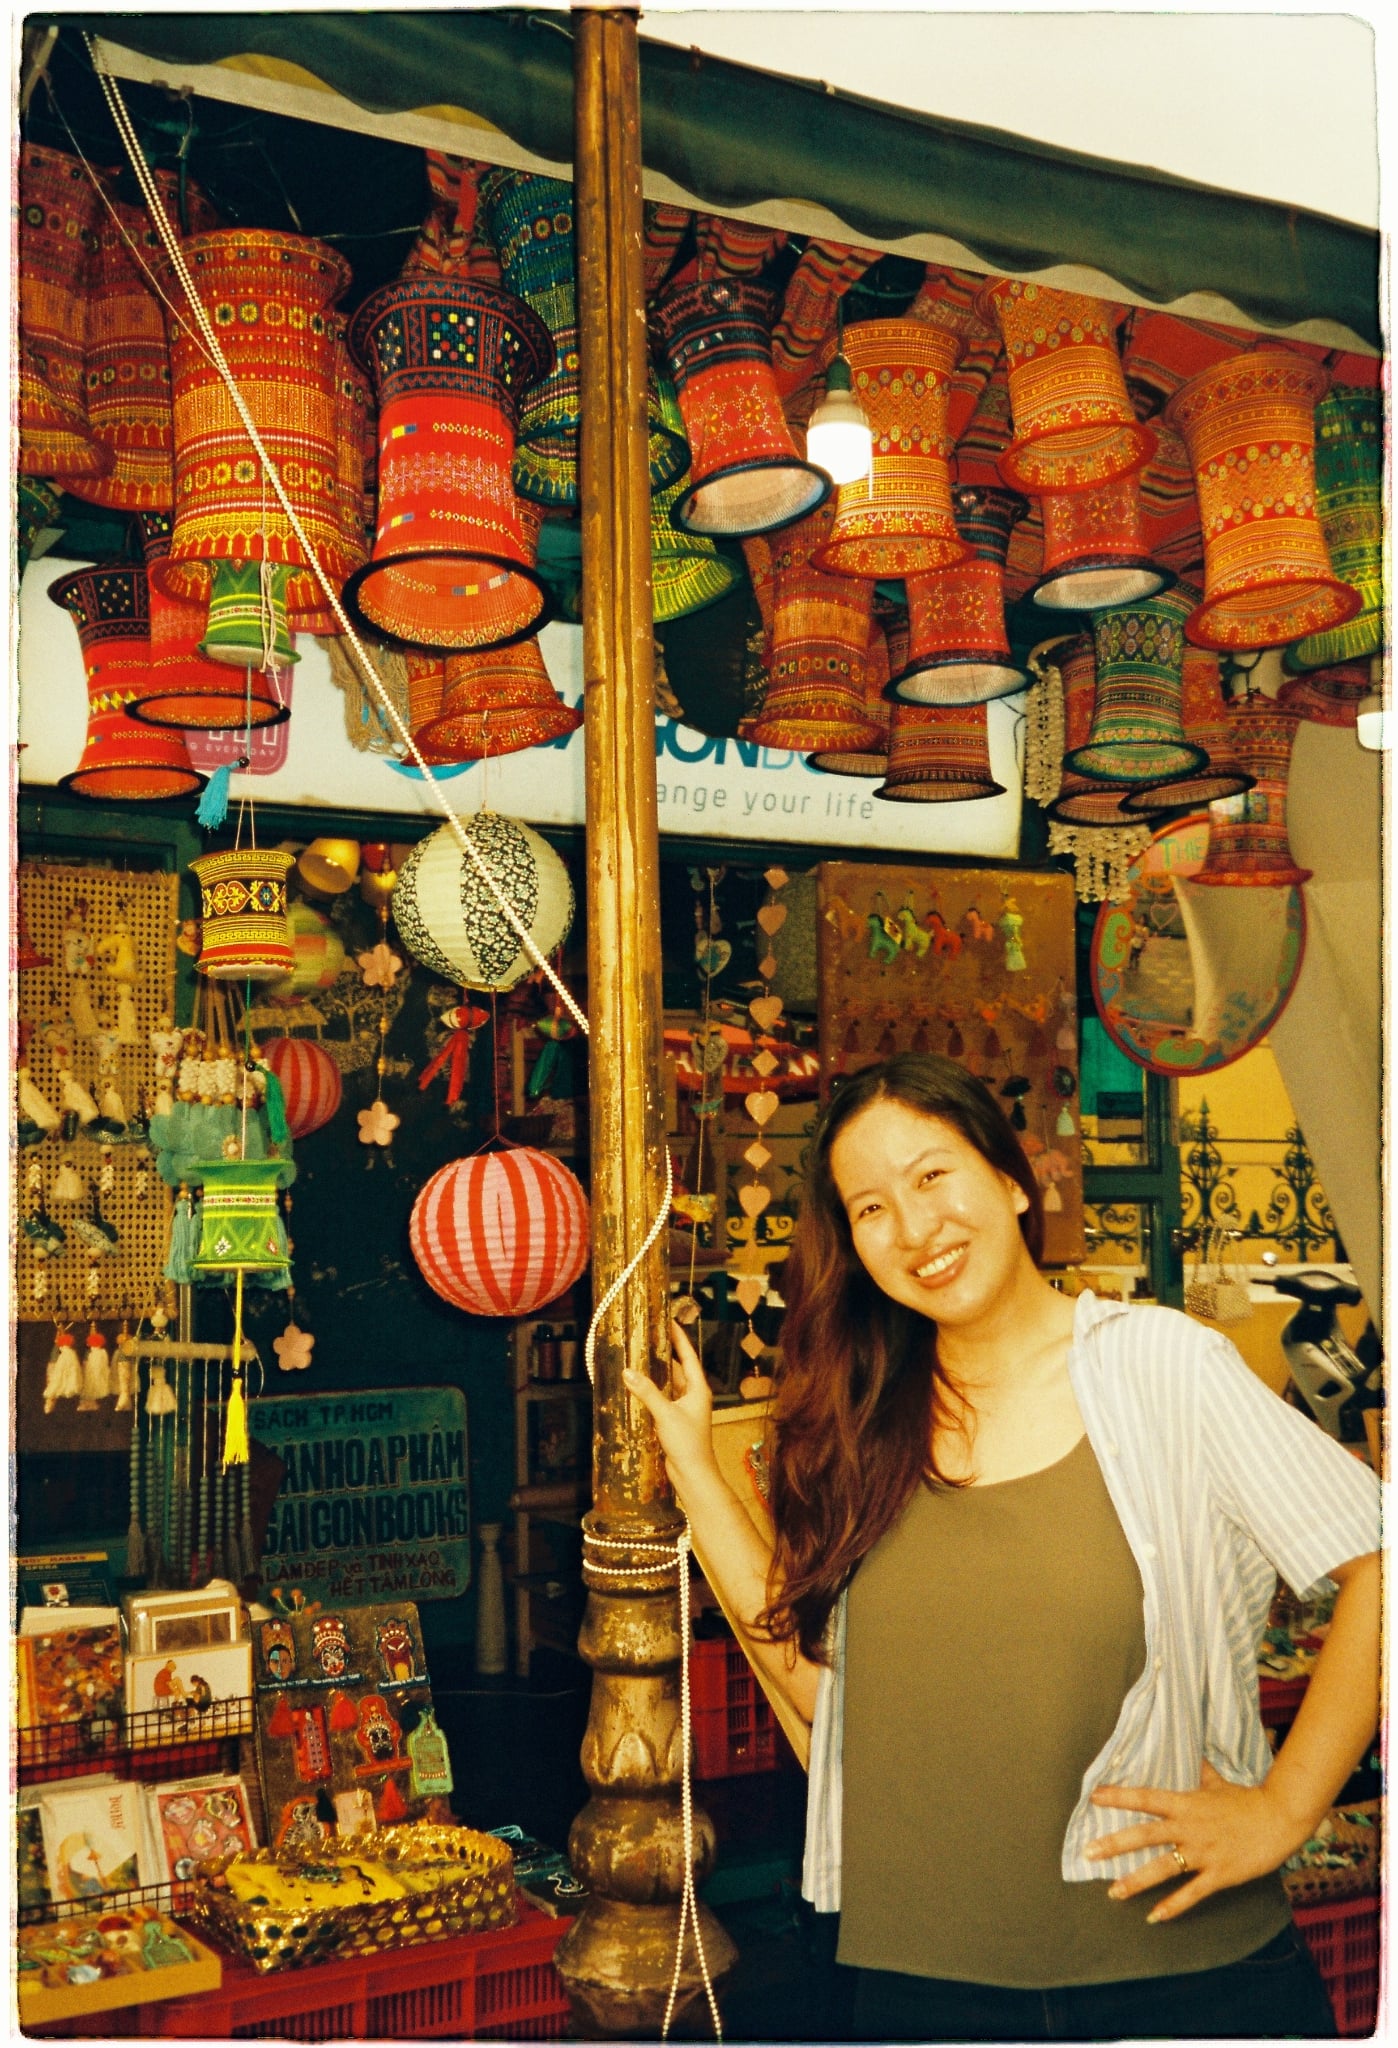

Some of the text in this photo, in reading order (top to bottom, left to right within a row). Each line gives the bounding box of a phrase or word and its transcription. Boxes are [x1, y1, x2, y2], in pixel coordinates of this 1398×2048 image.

[206, 743, 276, 756] EVERYDAY
[656, 783, 874, 819] ange your life
